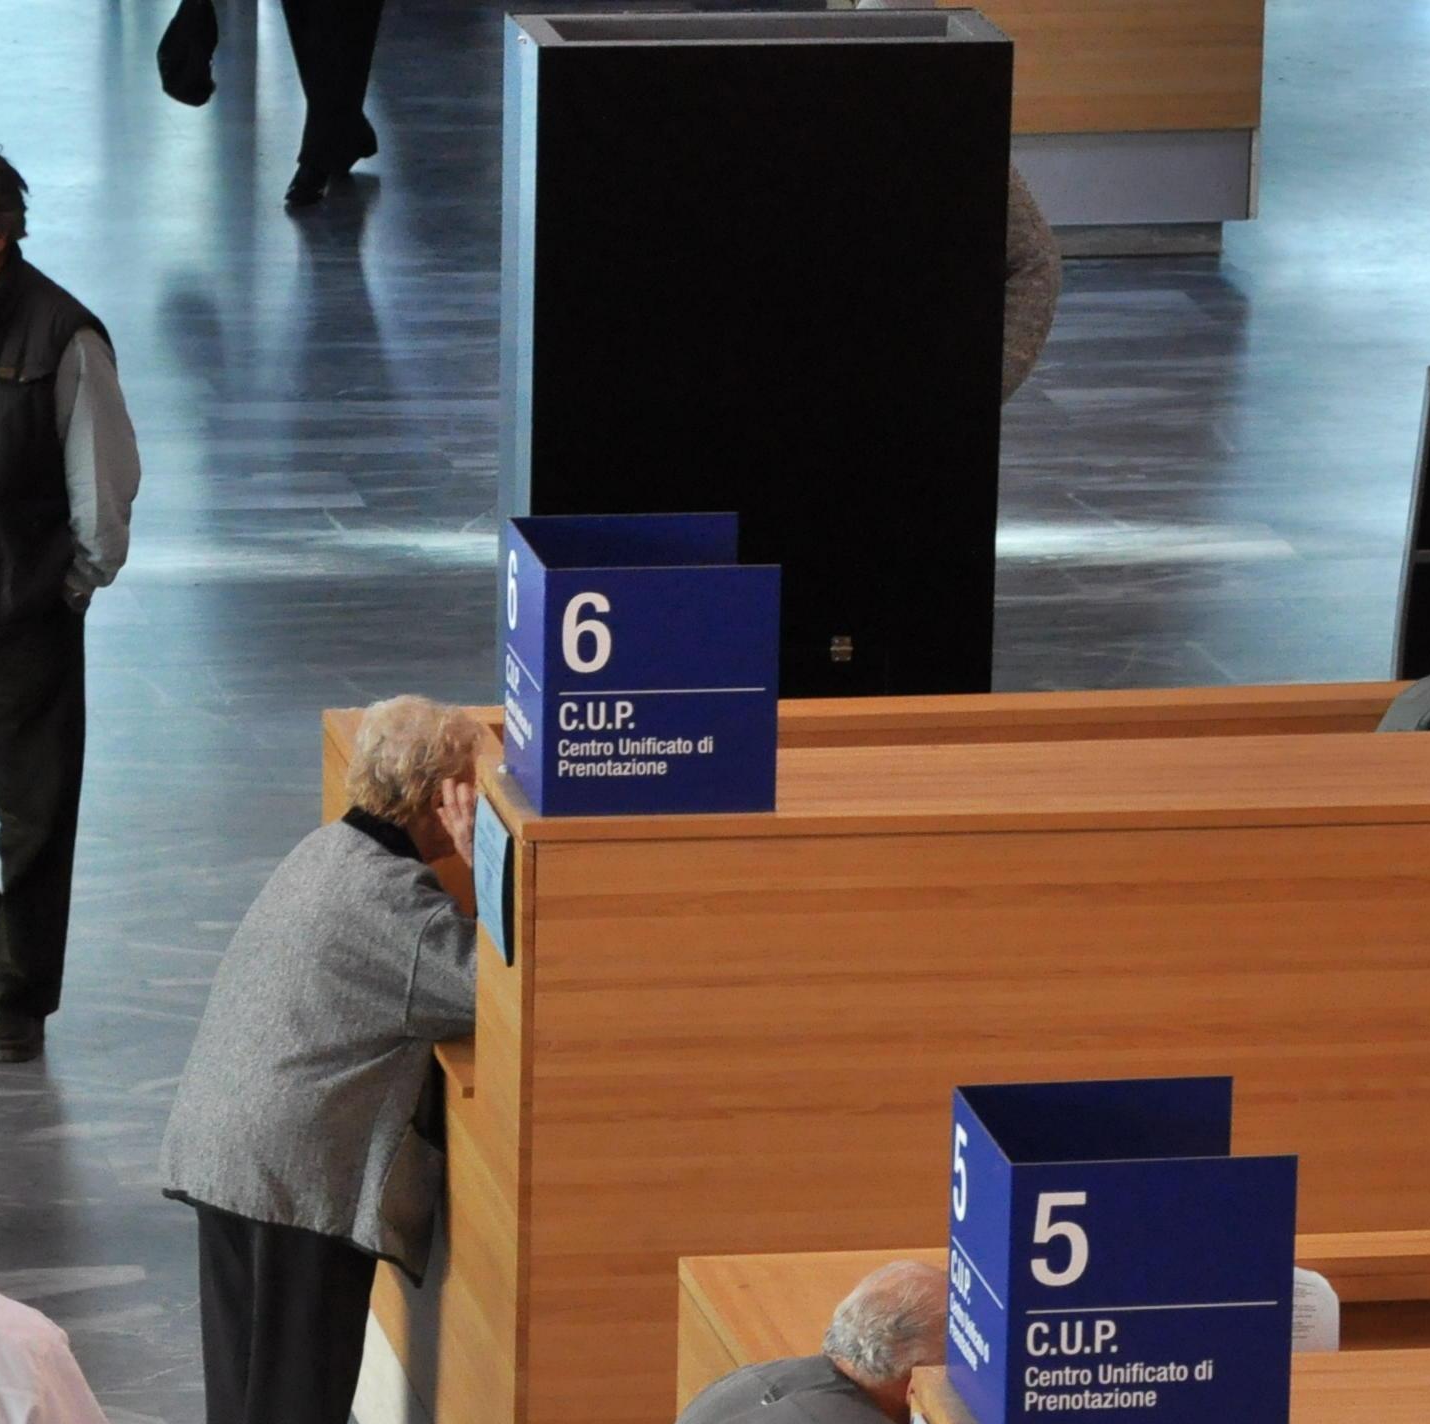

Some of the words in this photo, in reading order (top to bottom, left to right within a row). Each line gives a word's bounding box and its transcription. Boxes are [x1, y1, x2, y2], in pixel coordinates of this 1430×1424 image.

[507, 550, 517, 630] 6
[561, 591, 612, 673] 6
[558, 701, 635, 731] C.U.P.
[558, 739, 614, 757] Centro
[618, 736, 692, 756] Unificato
[697, 736, 713, 754] di
[558, 759, 667, 777] Prenotazione
[952, 1122, 968, 1222] 5
[1030, 1191, 1090, 1287] 5
[1026, 1320, 1119, 1357] C.U.P.
[1025, 1366, 1092, 1388] Centro
[1098, 1362, 1188, 1386] Unificato
[1194, 1360, 1213, 1382] di
[1025, 1387, 1157, 1411] Prenotazione
